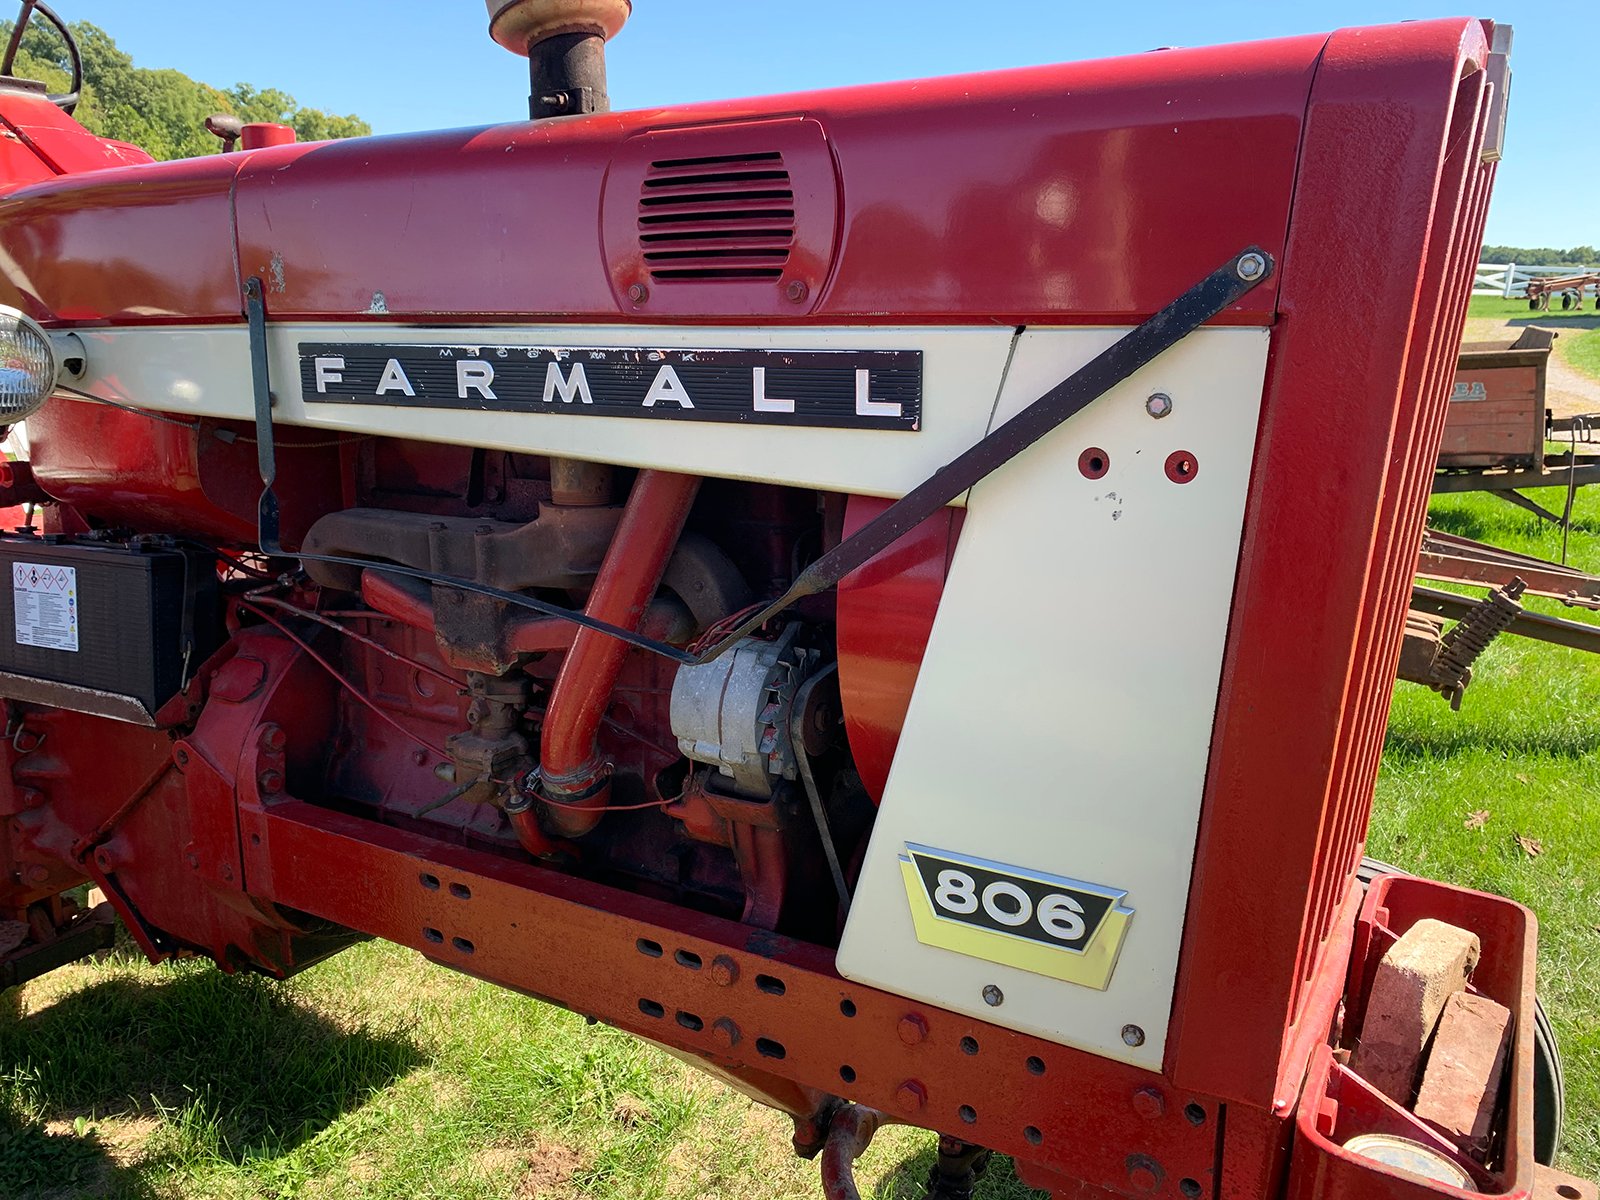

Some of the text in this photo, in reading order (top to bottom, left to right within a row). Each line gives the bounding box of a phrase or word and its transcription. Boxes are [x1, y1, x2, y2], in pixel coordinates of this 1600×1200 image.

[314, 356, 902, 417] FARMALL
[1454, 382, 1487, 397] EA
[934, 869, 1086, 941] 806
